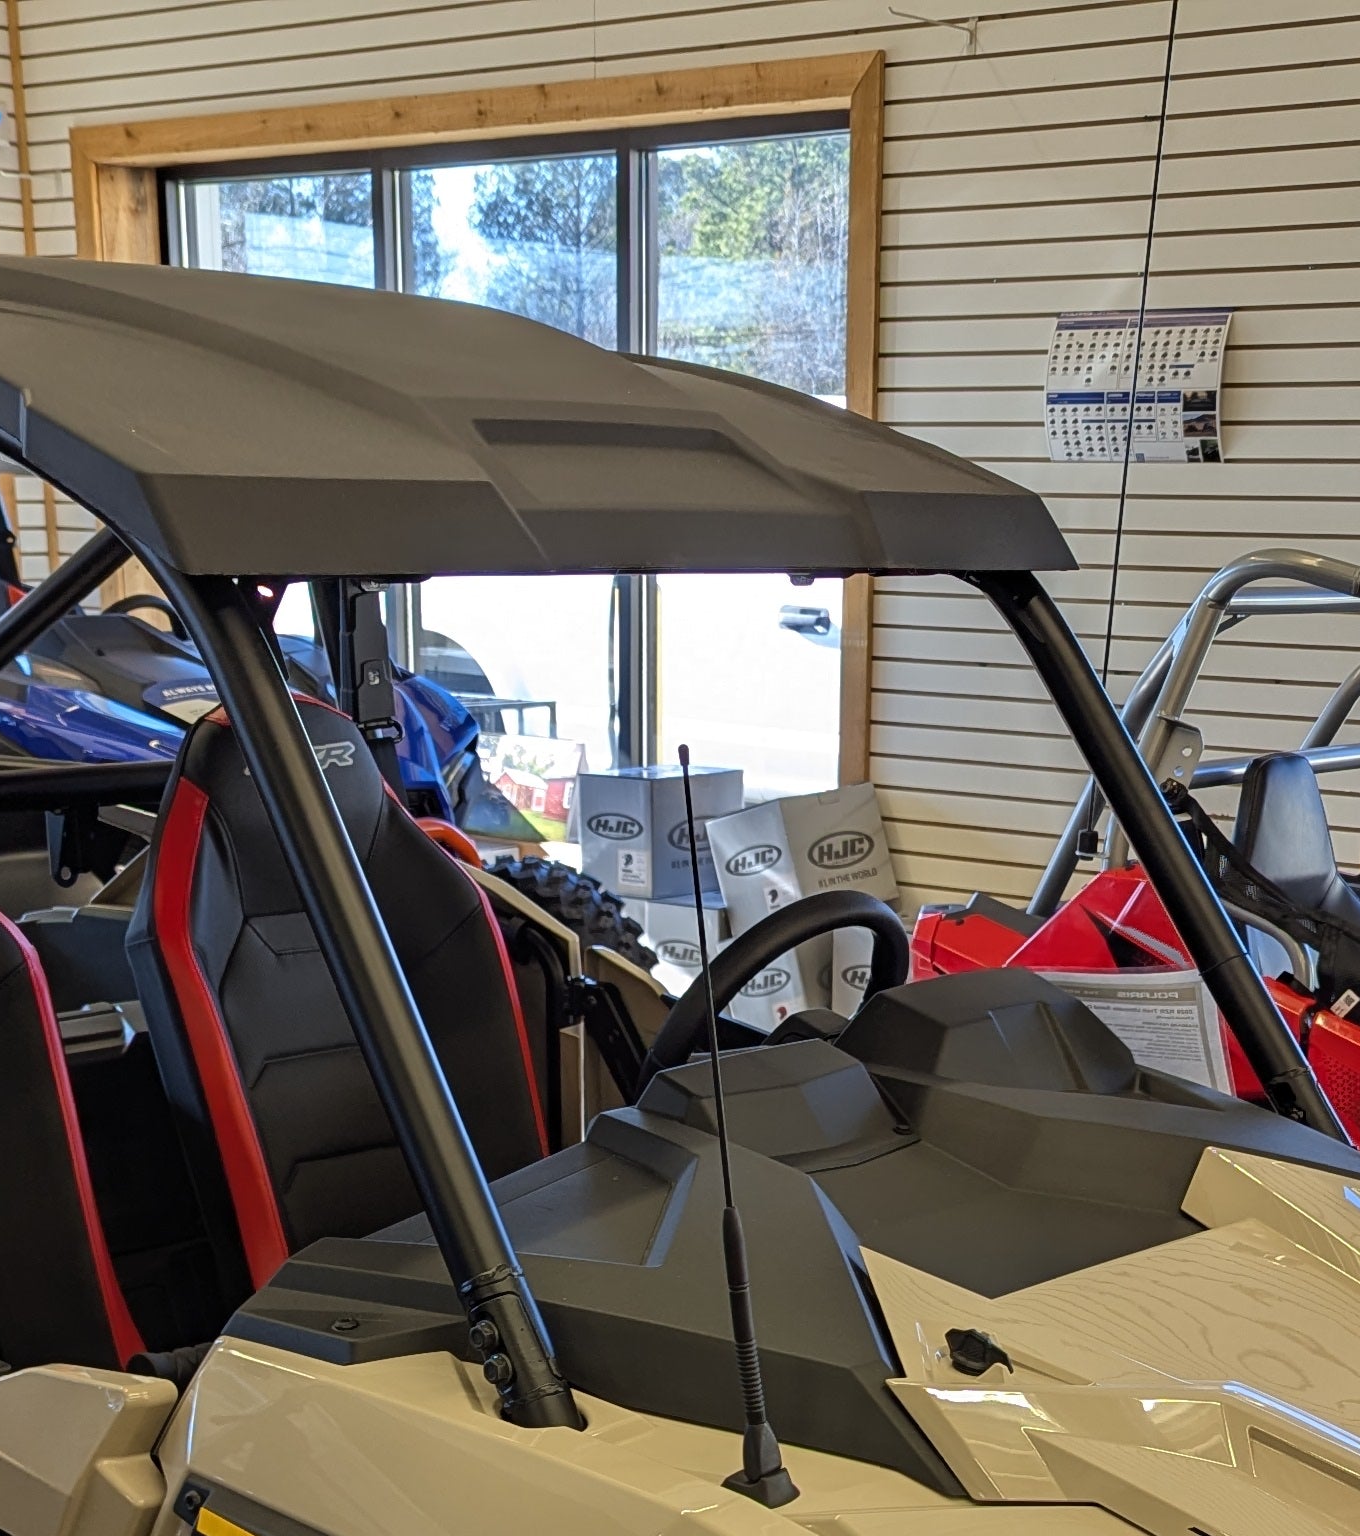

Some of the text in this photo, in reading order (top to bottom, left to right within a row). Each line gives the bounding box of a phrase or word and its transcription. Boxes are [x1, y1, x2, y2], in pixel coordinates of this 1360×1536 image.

[595, 817, 636, 835] HJC
[734, 848, 774, 873] HJC
[818, 837, 864, 864] HJC
[662, 944, 700, 962] HJC
